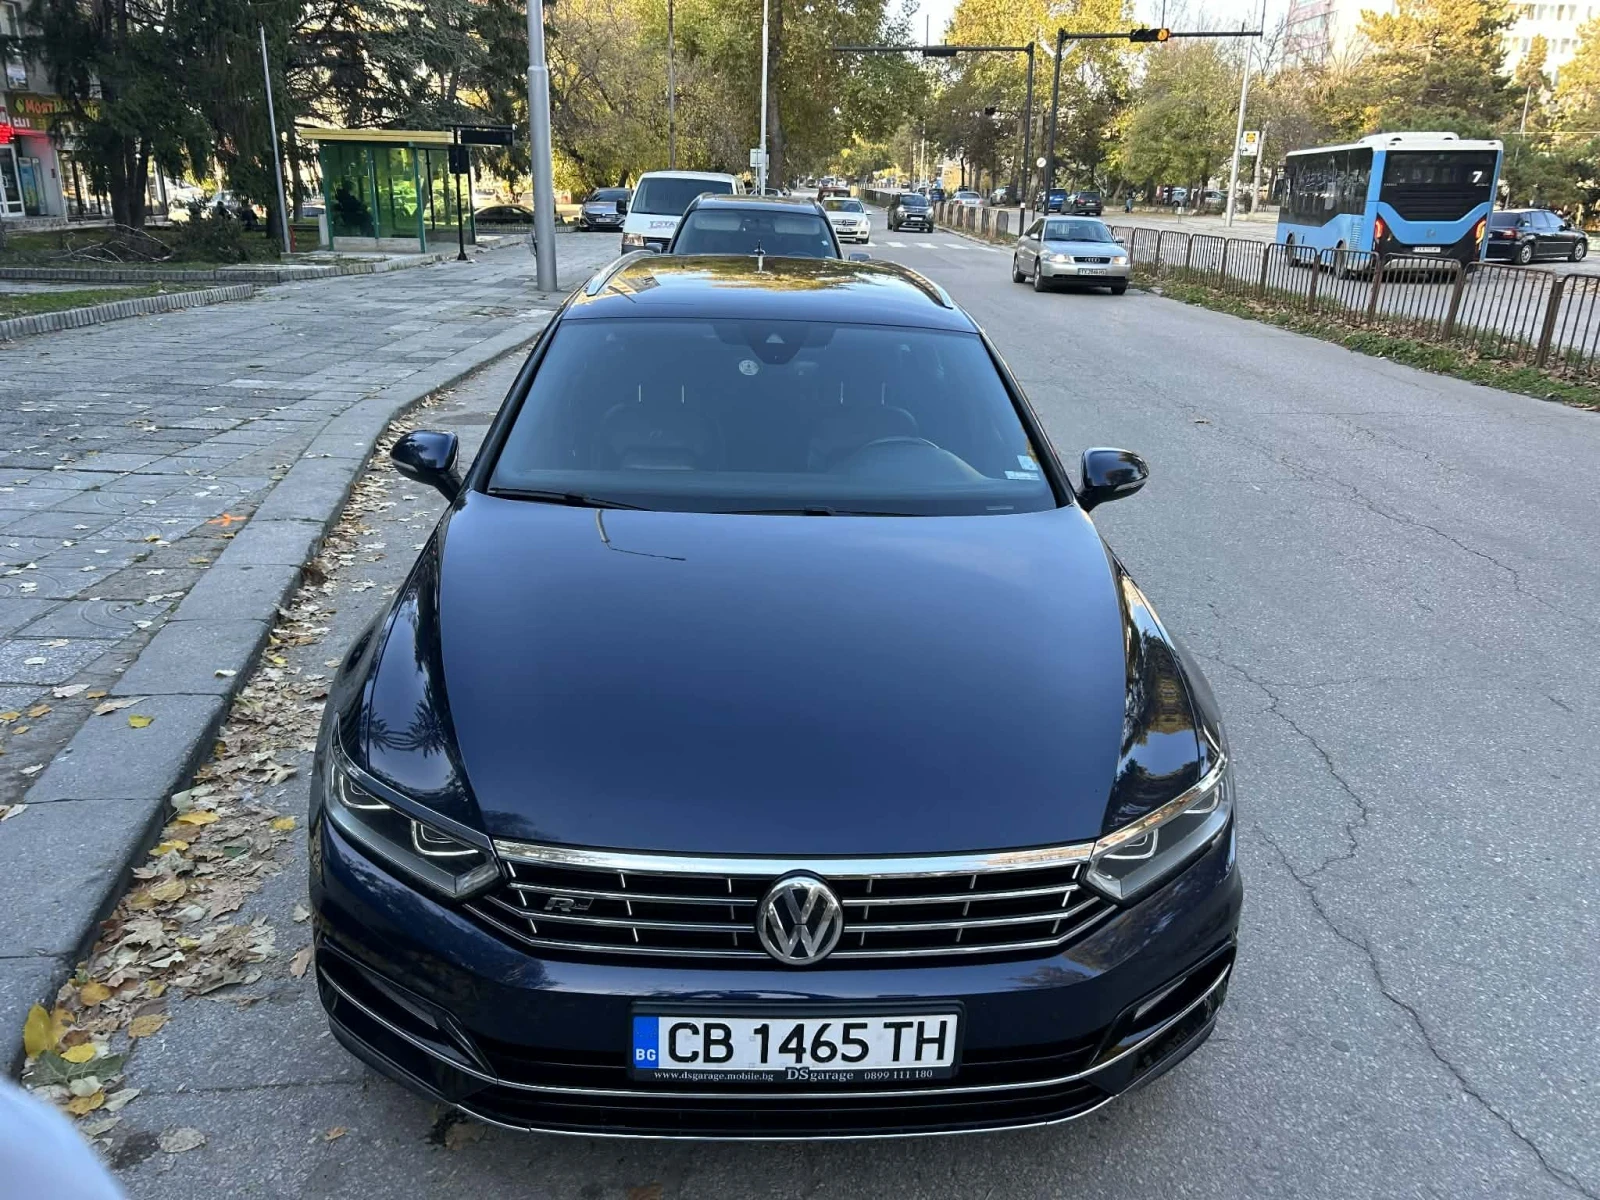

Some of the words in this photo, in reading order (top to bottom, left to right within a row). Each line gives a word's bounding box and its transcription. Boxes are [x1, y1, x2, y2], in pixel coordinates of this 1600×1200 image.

[1472, 170, 1483, 184] 7
[668, 1021, 734, 1064] CB
[753, 1022, 870, 1064] 1465
[883, 1020, 948, 1063] TH
[635, 1048, 657, 1061] BG
[653, 1070, 775, 1082] www.dsgarage.mobile.bg
[864, 1070, 890, 1081] 0899
[893, 1070, 911, 1080] 111
[915, 1069, 933, 1079] 180
